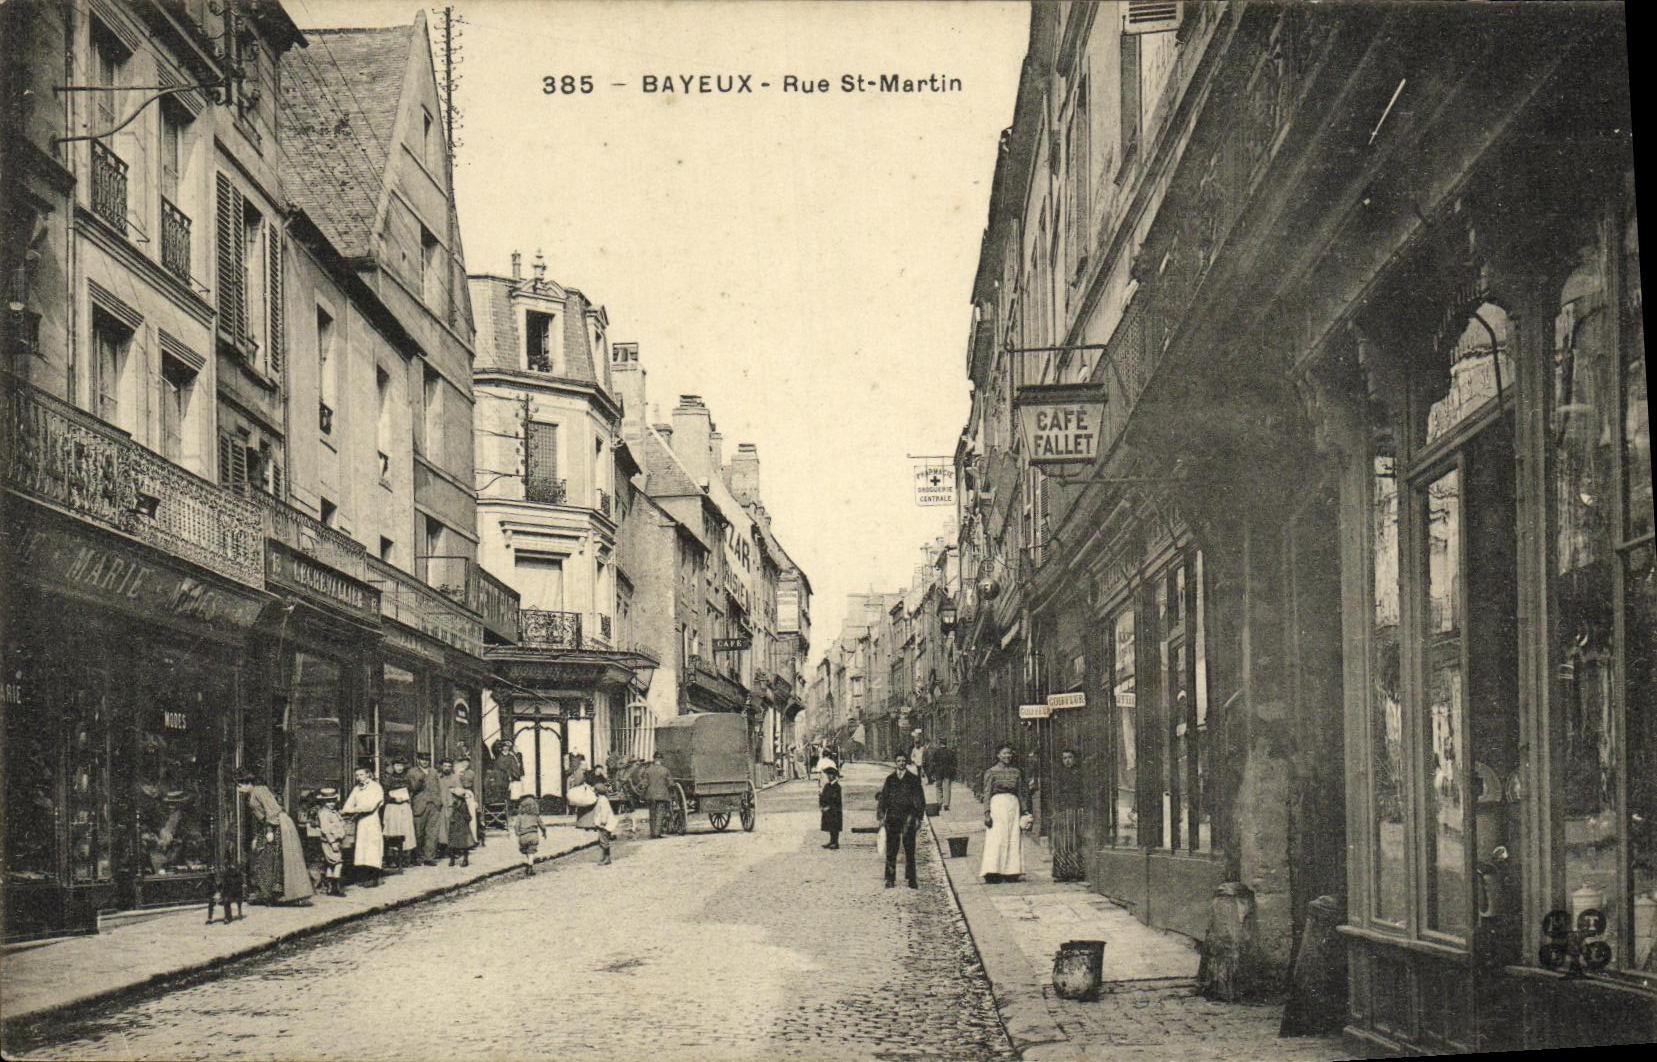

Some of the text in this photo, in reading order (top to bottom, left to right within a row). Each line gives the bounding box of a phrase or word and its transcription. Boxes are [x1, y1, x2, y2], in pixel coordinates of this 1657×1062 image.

[1035, 404, 1088, 432] CAFÉ
[1033, 433, 1094, 456] FALLET
[916, 468, 954, 480] PHARMACIE
[65, 548, 150, 599] MARIE
[164, 710, 187, 730] MODES
